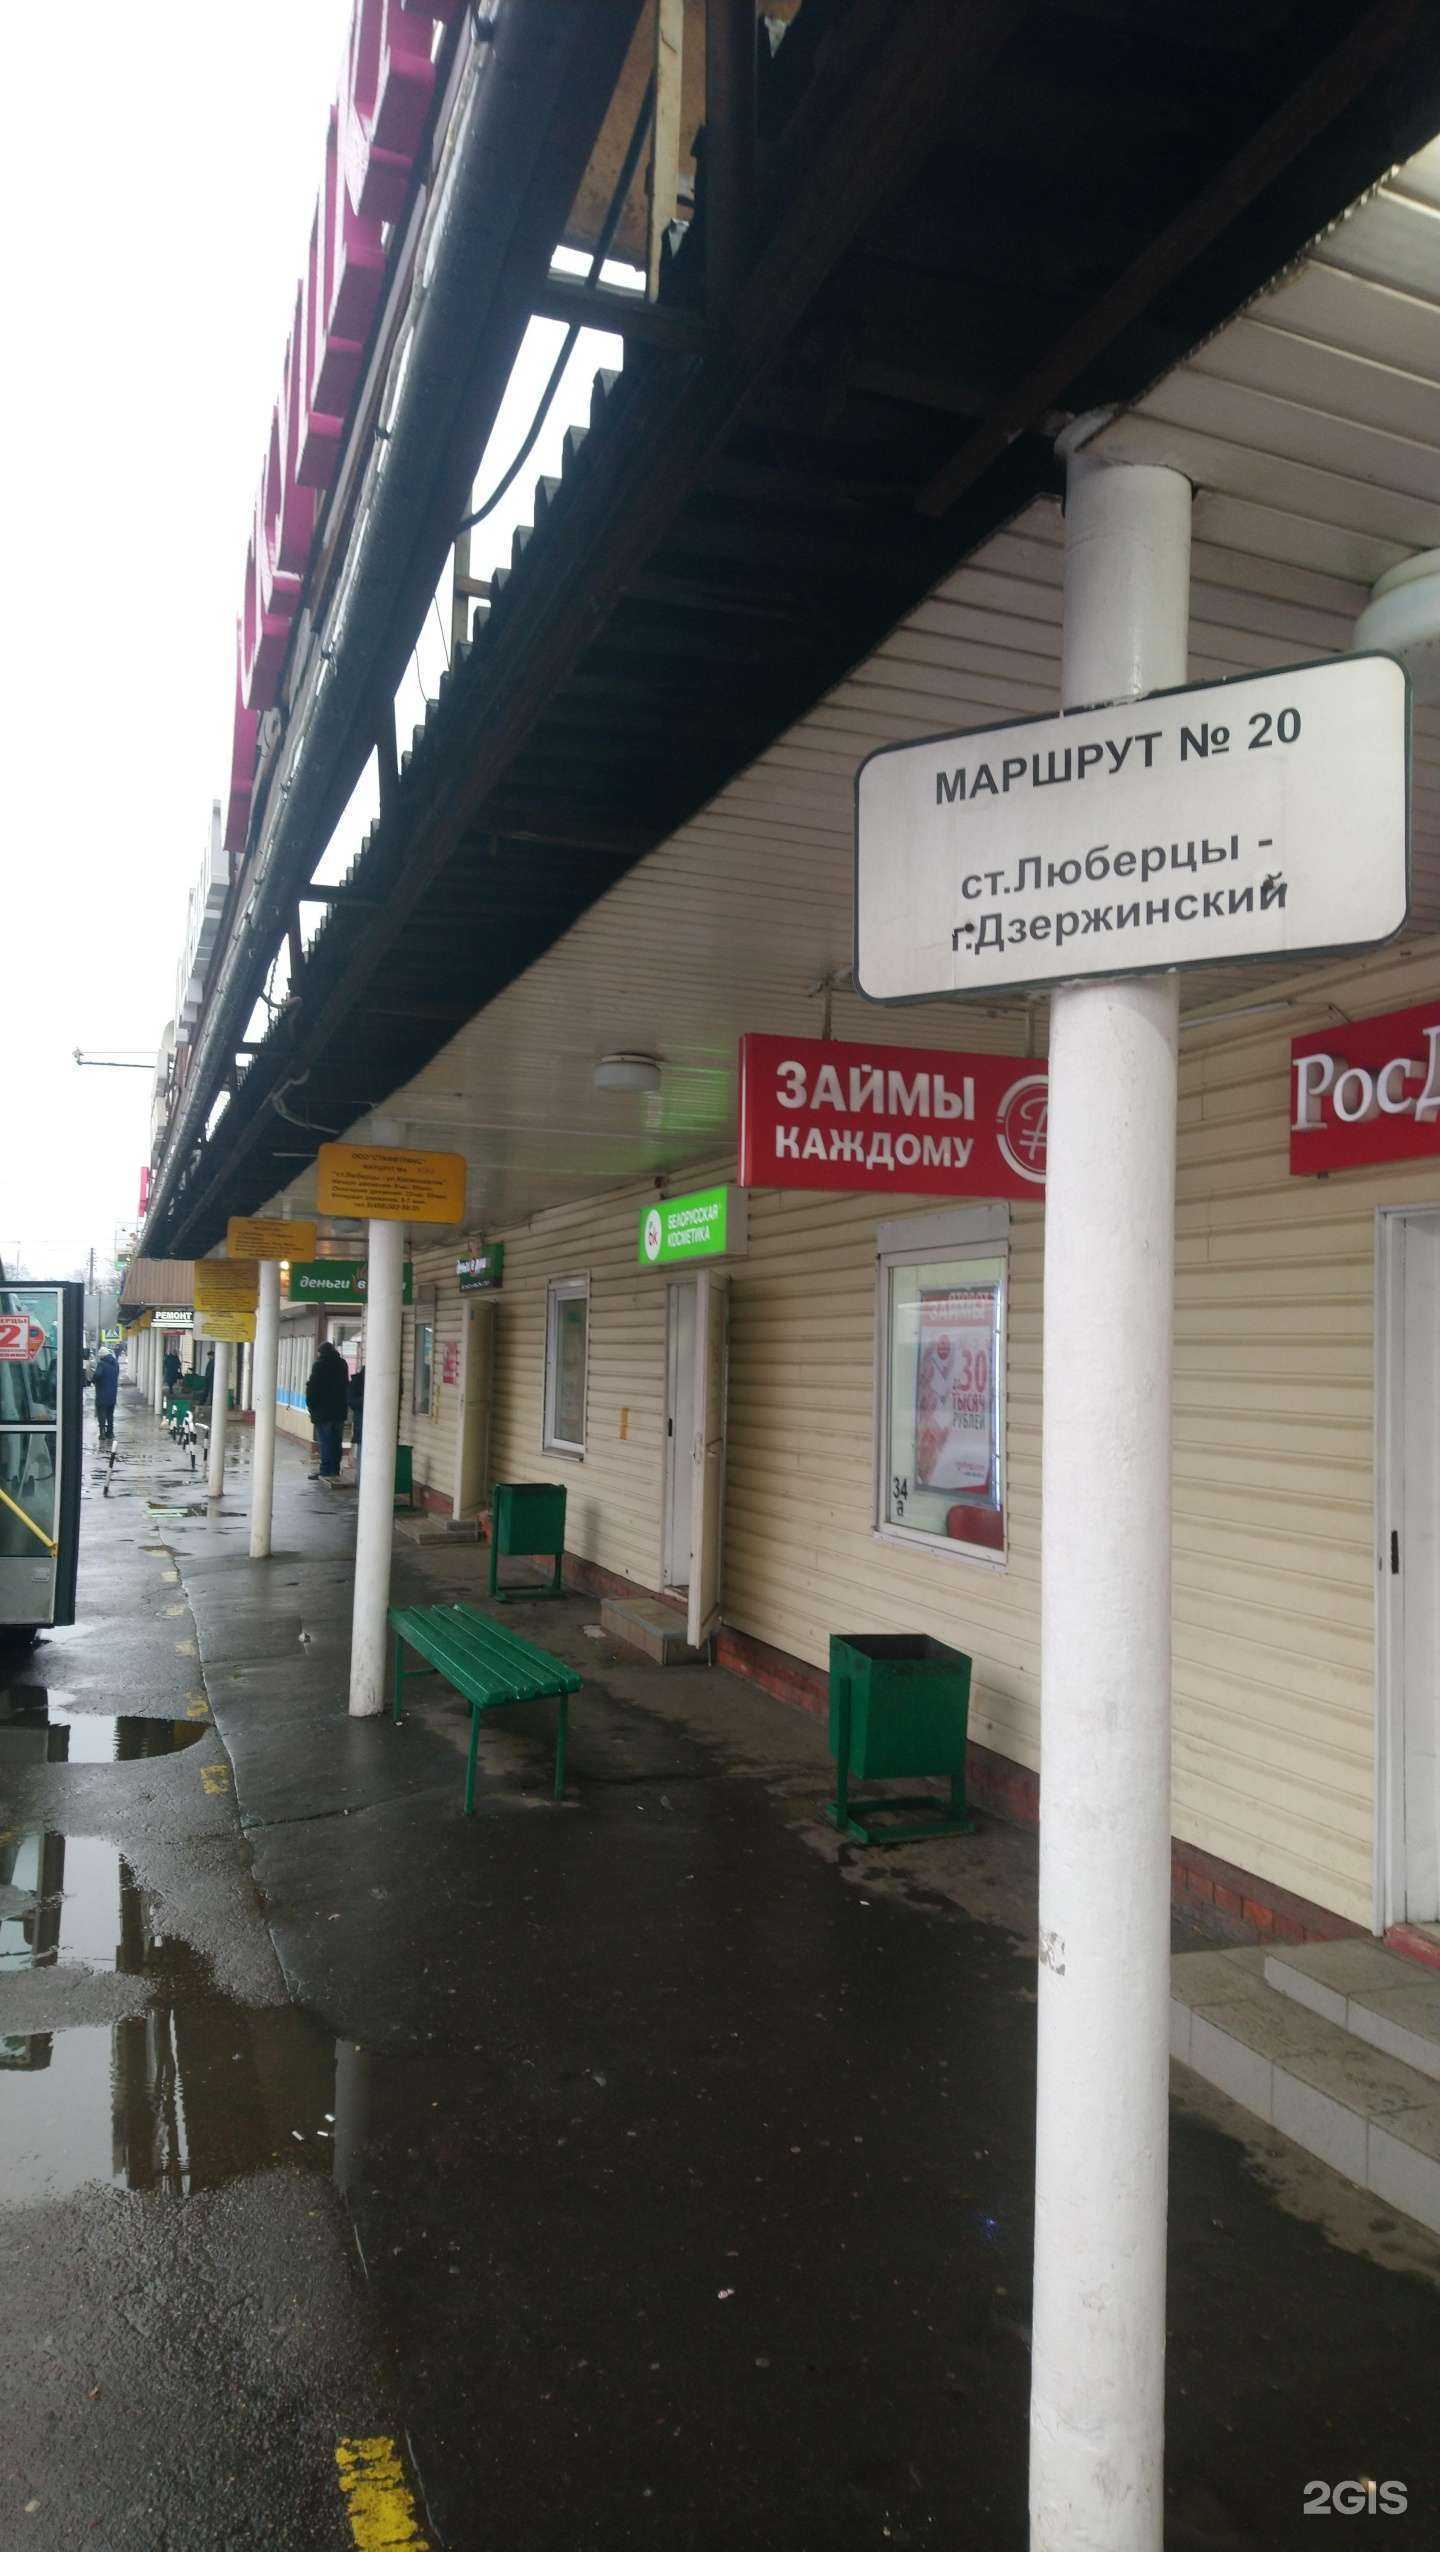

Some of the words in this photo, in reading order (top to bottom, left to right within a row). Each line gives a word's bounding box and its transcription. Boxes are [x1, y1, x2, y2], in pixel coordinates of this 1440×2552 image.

[936, 730, 1162, 805] МАРШРУТ
[1180, 723, 1231, 761] №
[1247, 708, 1302, 750] 20
[961, 834, 1239, 900] ст.Люберцы
[952, 872, 1288, 955] г.Дзержинский
[776, 1061, 976, 1120] ЗАЙМЫ
[775, 1126, 974, 1171] КАЖДОМУ
[668, 1204, 719, 1230] БЕЛОРУССКАЯ
[668, 1226, 710, 1247] КОСМЕТИКА
[300, 1275, 350, 1289] деньги
[155, 1311, 193, 1320] РЕМОНТ
[960, 1348, 987, 1393] 30
[893, 1477, 908, 1500] 34
